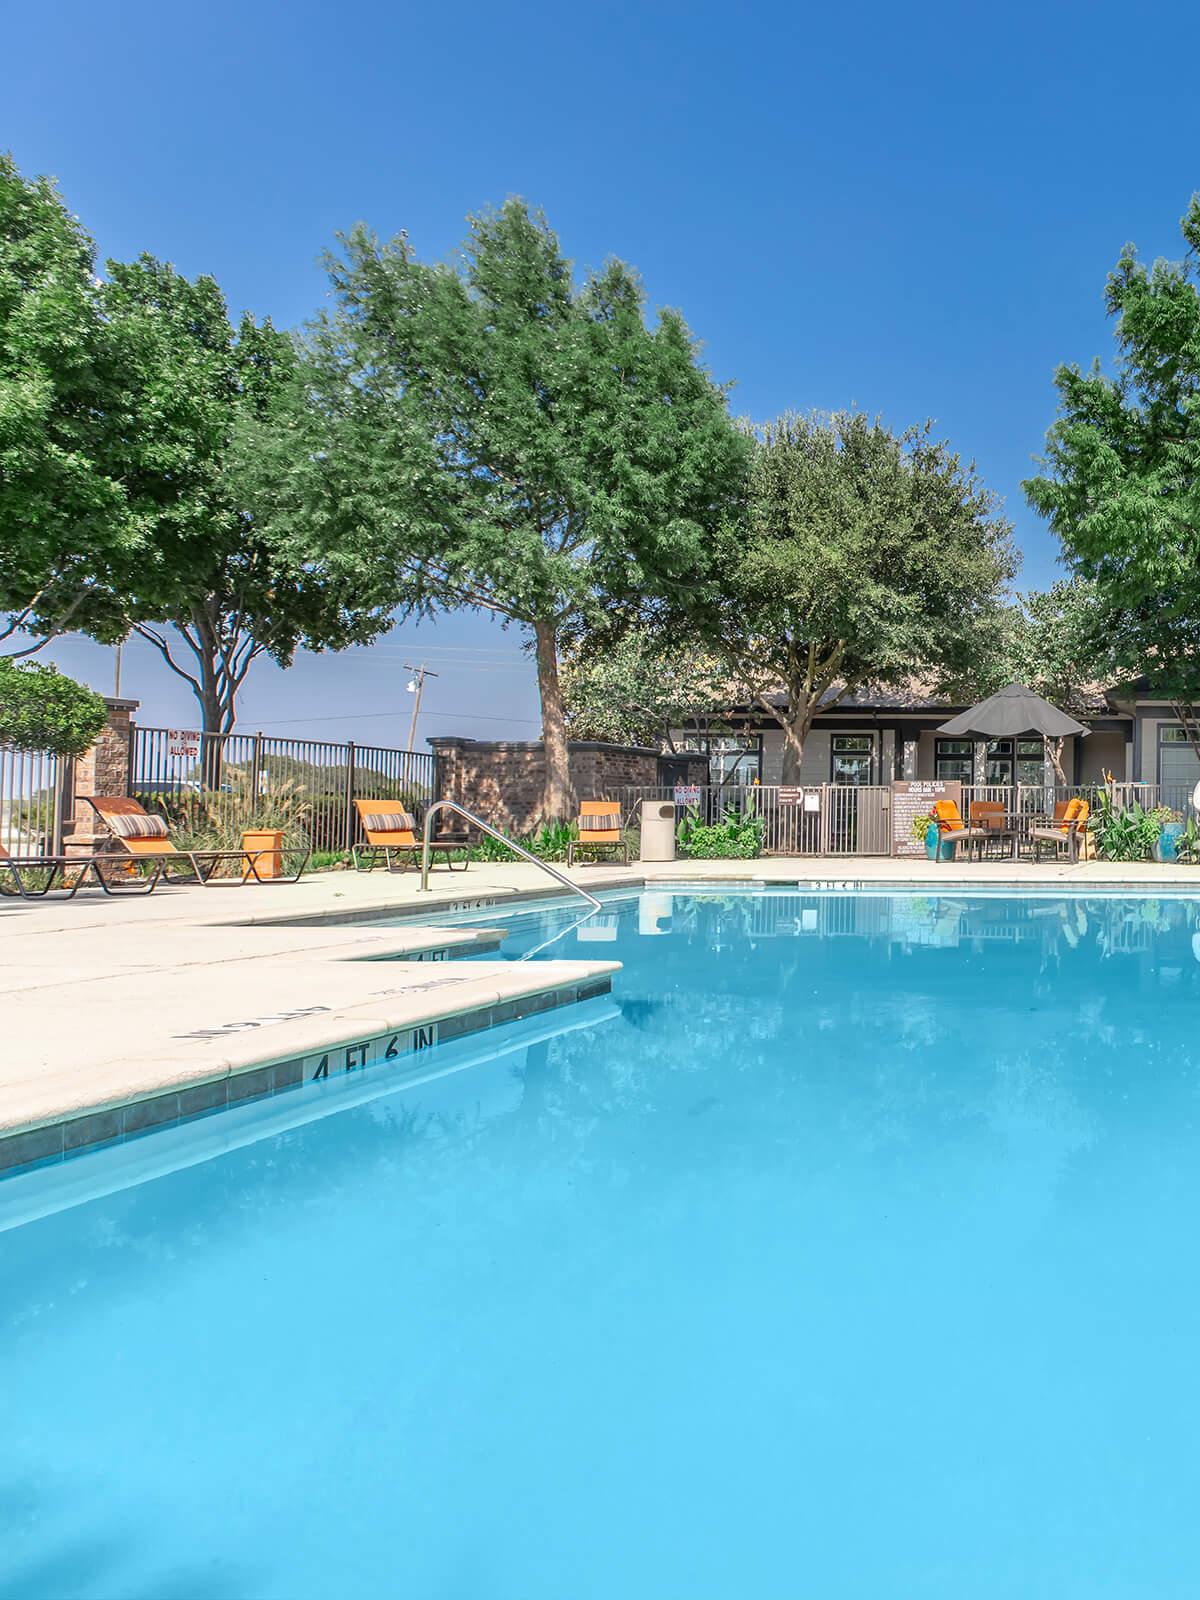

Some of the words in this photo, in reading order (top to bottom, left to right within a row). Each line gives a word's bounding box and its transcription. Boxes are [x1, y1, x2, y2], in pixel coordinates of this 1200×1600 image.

[170, 747, 198, 756] ALLOWED
[432, 950, 446, 962] FT
[311, 1054, 329, 1080] 4
[346, 1043, 370, 1072] FT
[384, 1035, 399, 1059] 6
[413, 1026, 433, 1051] IN
